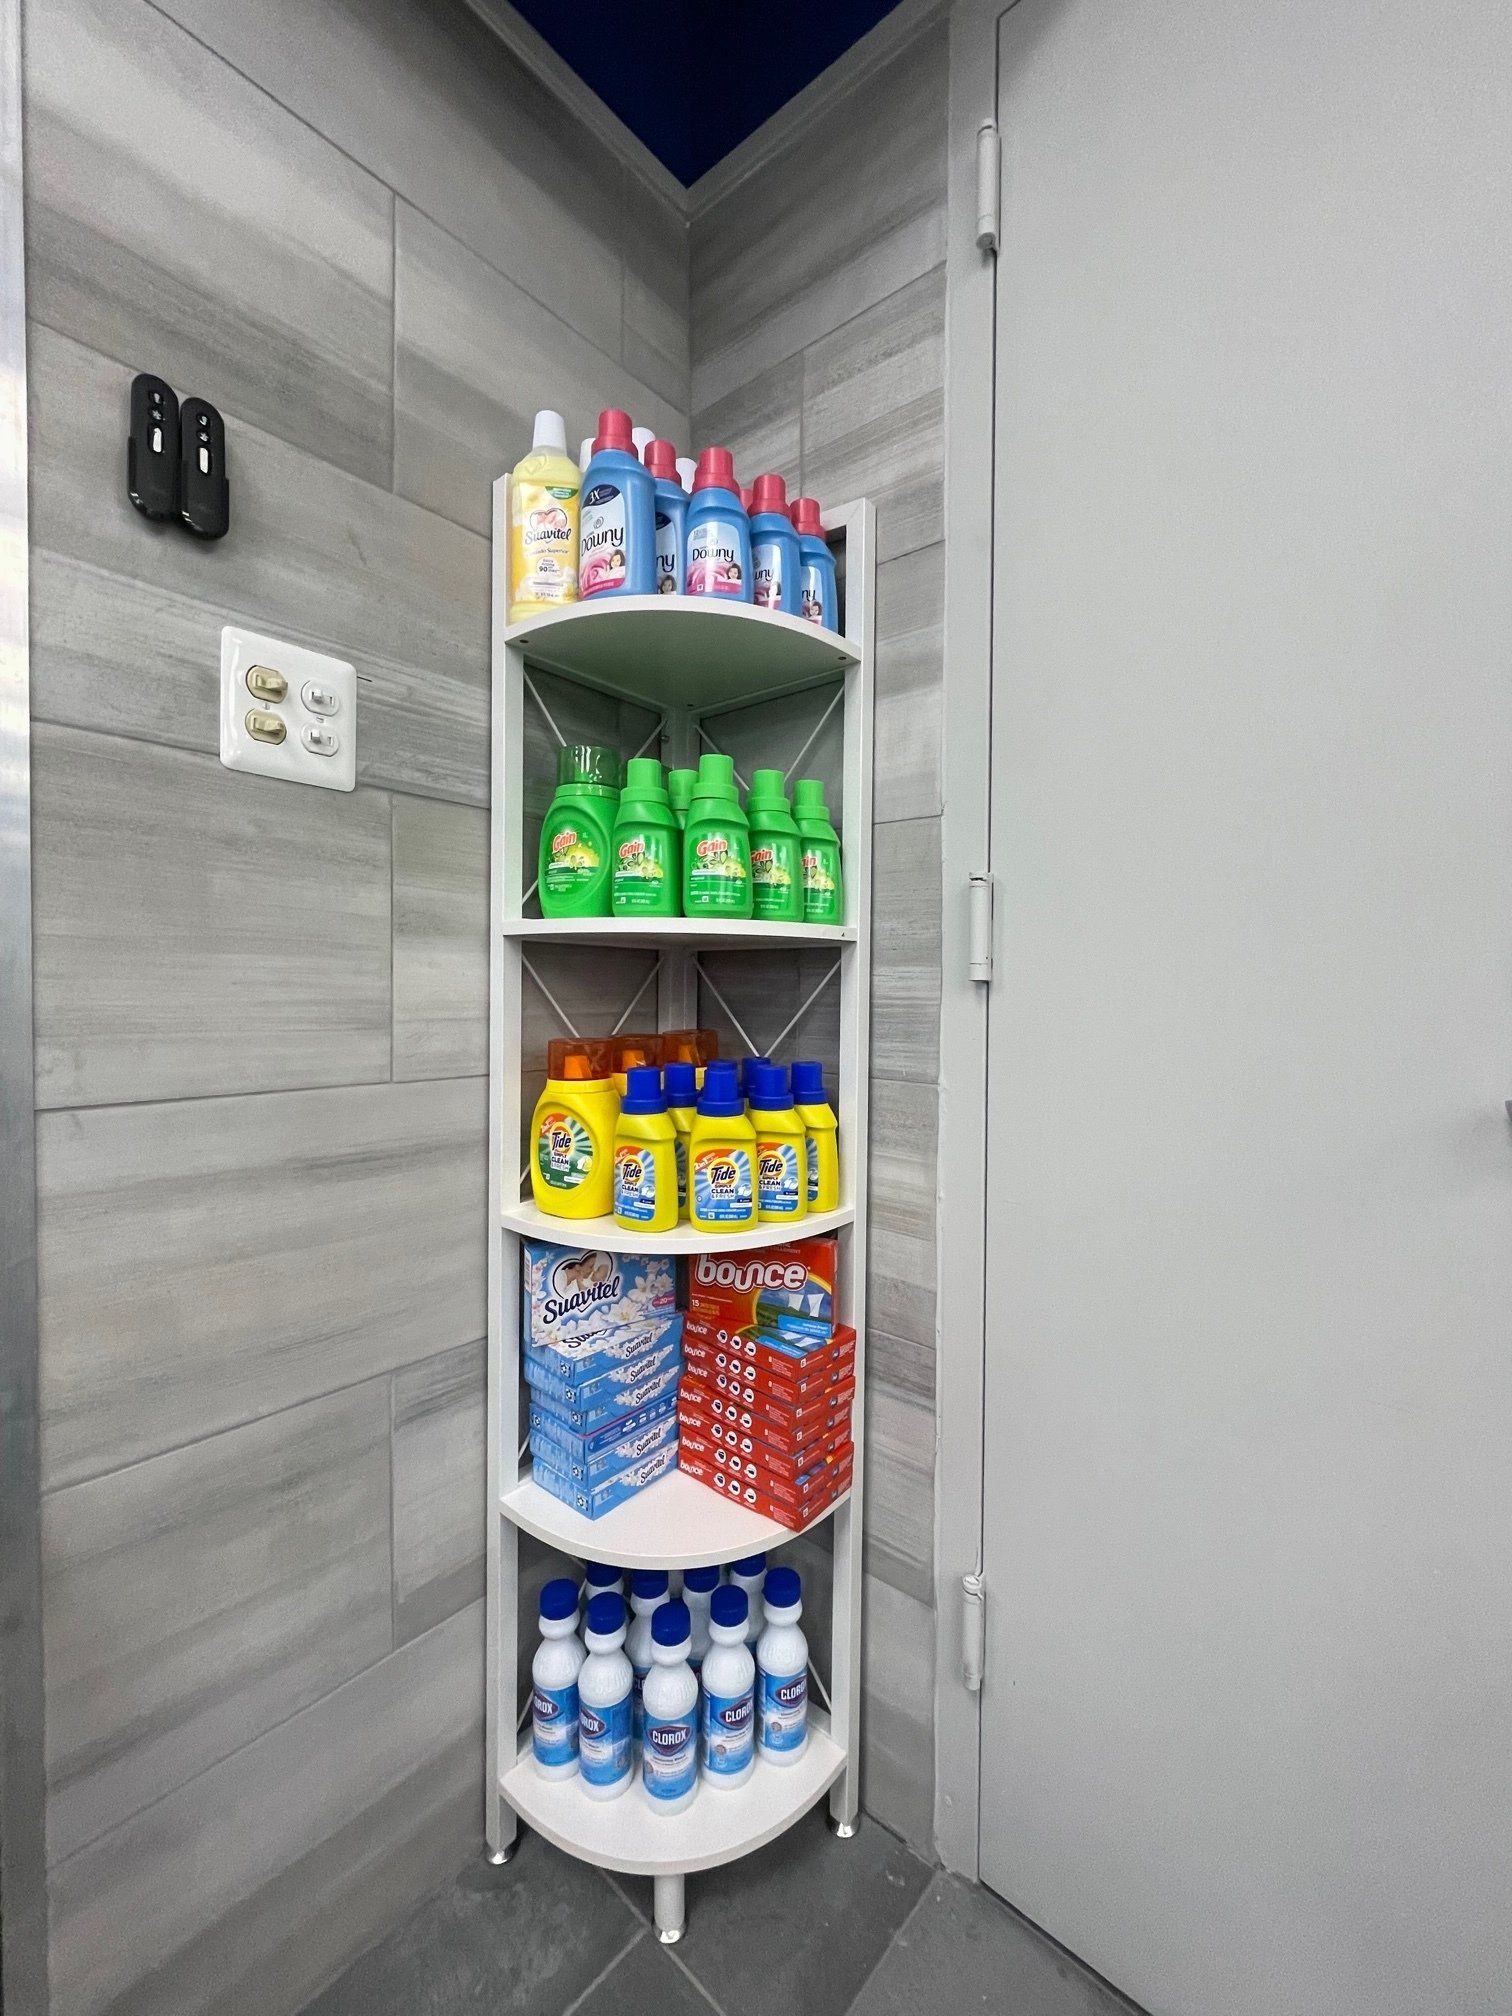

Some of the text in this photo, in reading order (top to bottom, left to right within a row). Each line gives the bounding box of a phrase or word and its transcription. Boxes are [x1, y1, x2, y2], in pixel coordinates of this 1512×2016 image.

[524, 528, 572, 545] Suavitel
[692, 548, 734, 563] Downy
[754, 568, 774, 582] wny
[553, 831, 577, 852] Gain
[620, 841, 645, 858] Gain
[697, 840, 728, 856] Gain
[552, 1132, 572, 1150] Tide
[551, 1156, 569, 1165] CLEAN
[760, 1159, 783, 1176] Tide
[623, 1163, 642, 1180] Tide
[711, 1166, 736, 1184] Tide
[696, 1253, 808, 1293] bounce
[542, 1276, 620, 1324] Suavitel
[686, 1321, 708, 1335] bounce
[625, 1332, 653, 1358] Suavitel
[684, 1343, 706, 1358] bounce
[630, 1356, 656, 1382] Suavitel
[687, 1362, 708, 1378] bounce
[635, 1378, 661, 1404] Suavitel
[680, 1388, 702, 1403] bounce
[679, 1412, 702, 1427] bounce
[636, 1428, 662, 1456] Suavitel
[682, 1436, 705, 1452] bounce
[640, 1455, 666, 1484] Suavitel
[680, 1460, 704, 1476] bounce
[652, 1728, 687, 1745] CLOROX
